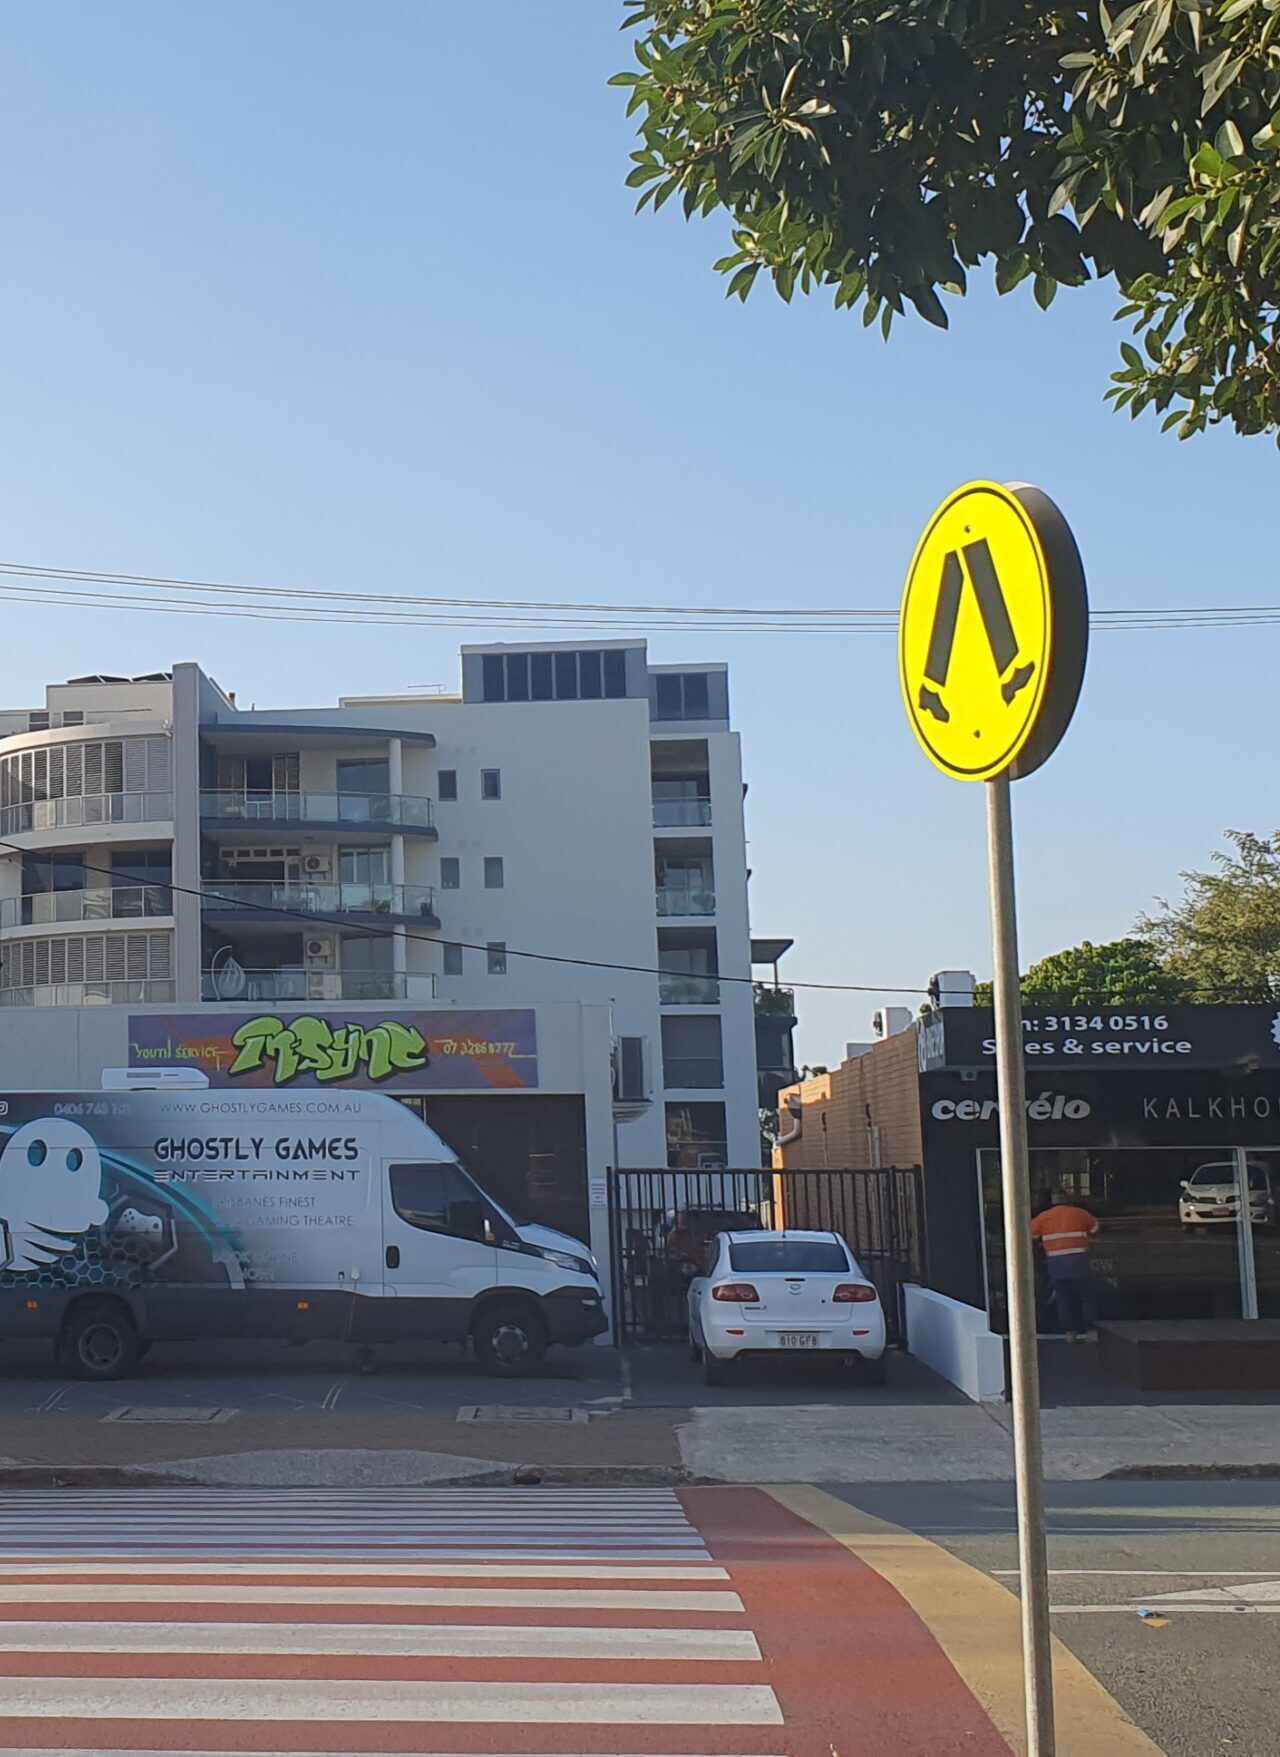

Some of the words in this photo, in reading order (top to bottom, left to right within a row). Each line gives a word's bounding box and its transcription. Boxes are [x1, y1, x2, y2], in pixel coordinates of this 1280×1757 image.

[1045, 1015, 1103, 1032] 3134
[1108, 1015, 1169, 1031] 0516
[982, 1038, 1056, 1054] Ses
[1061, 1037, 1084, 1054] &
[1090, 1037, 1193, 1054] service
[931, 1092, 1091, 1120] cerélo
[1143, 1097, 1280, 1119] KALKHO
[153, 1137, 264, 1161] GHOSTLY
[274, 1137, 358, 1161] GAMES
[153, 1169, 360, 1181] ENTERTAINMENT
[279, 1196, 316, 1208] FINEST
[304, 1215, 353, 1227] THEATRE
